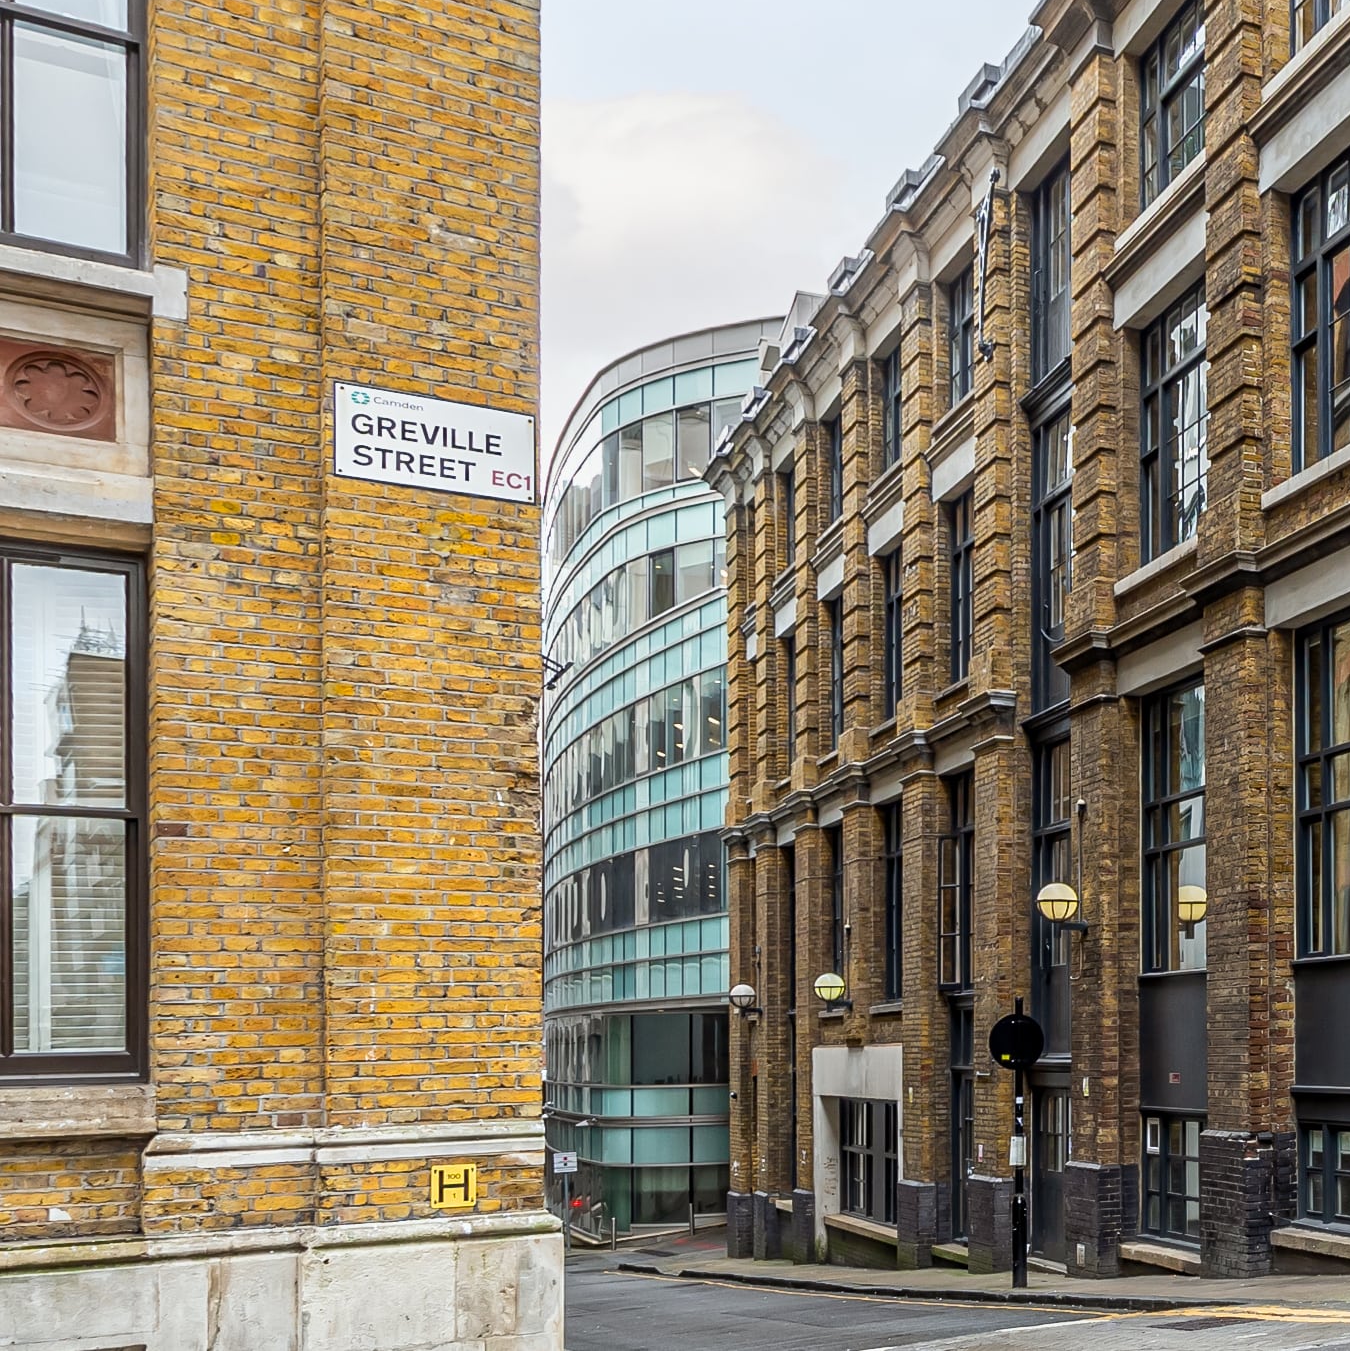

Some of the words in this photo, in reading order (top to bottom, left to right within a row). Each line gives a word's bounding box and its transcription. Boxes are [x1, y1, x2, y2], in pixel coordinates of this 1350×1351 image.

[373, 396, 424, 412] Camden
[351, 413, 502, 456] GREVILLE
[352, 444, 476, 482] STREET
[491, 469, 531, 491] EC1
[438, 1168, 469, 1203] H
